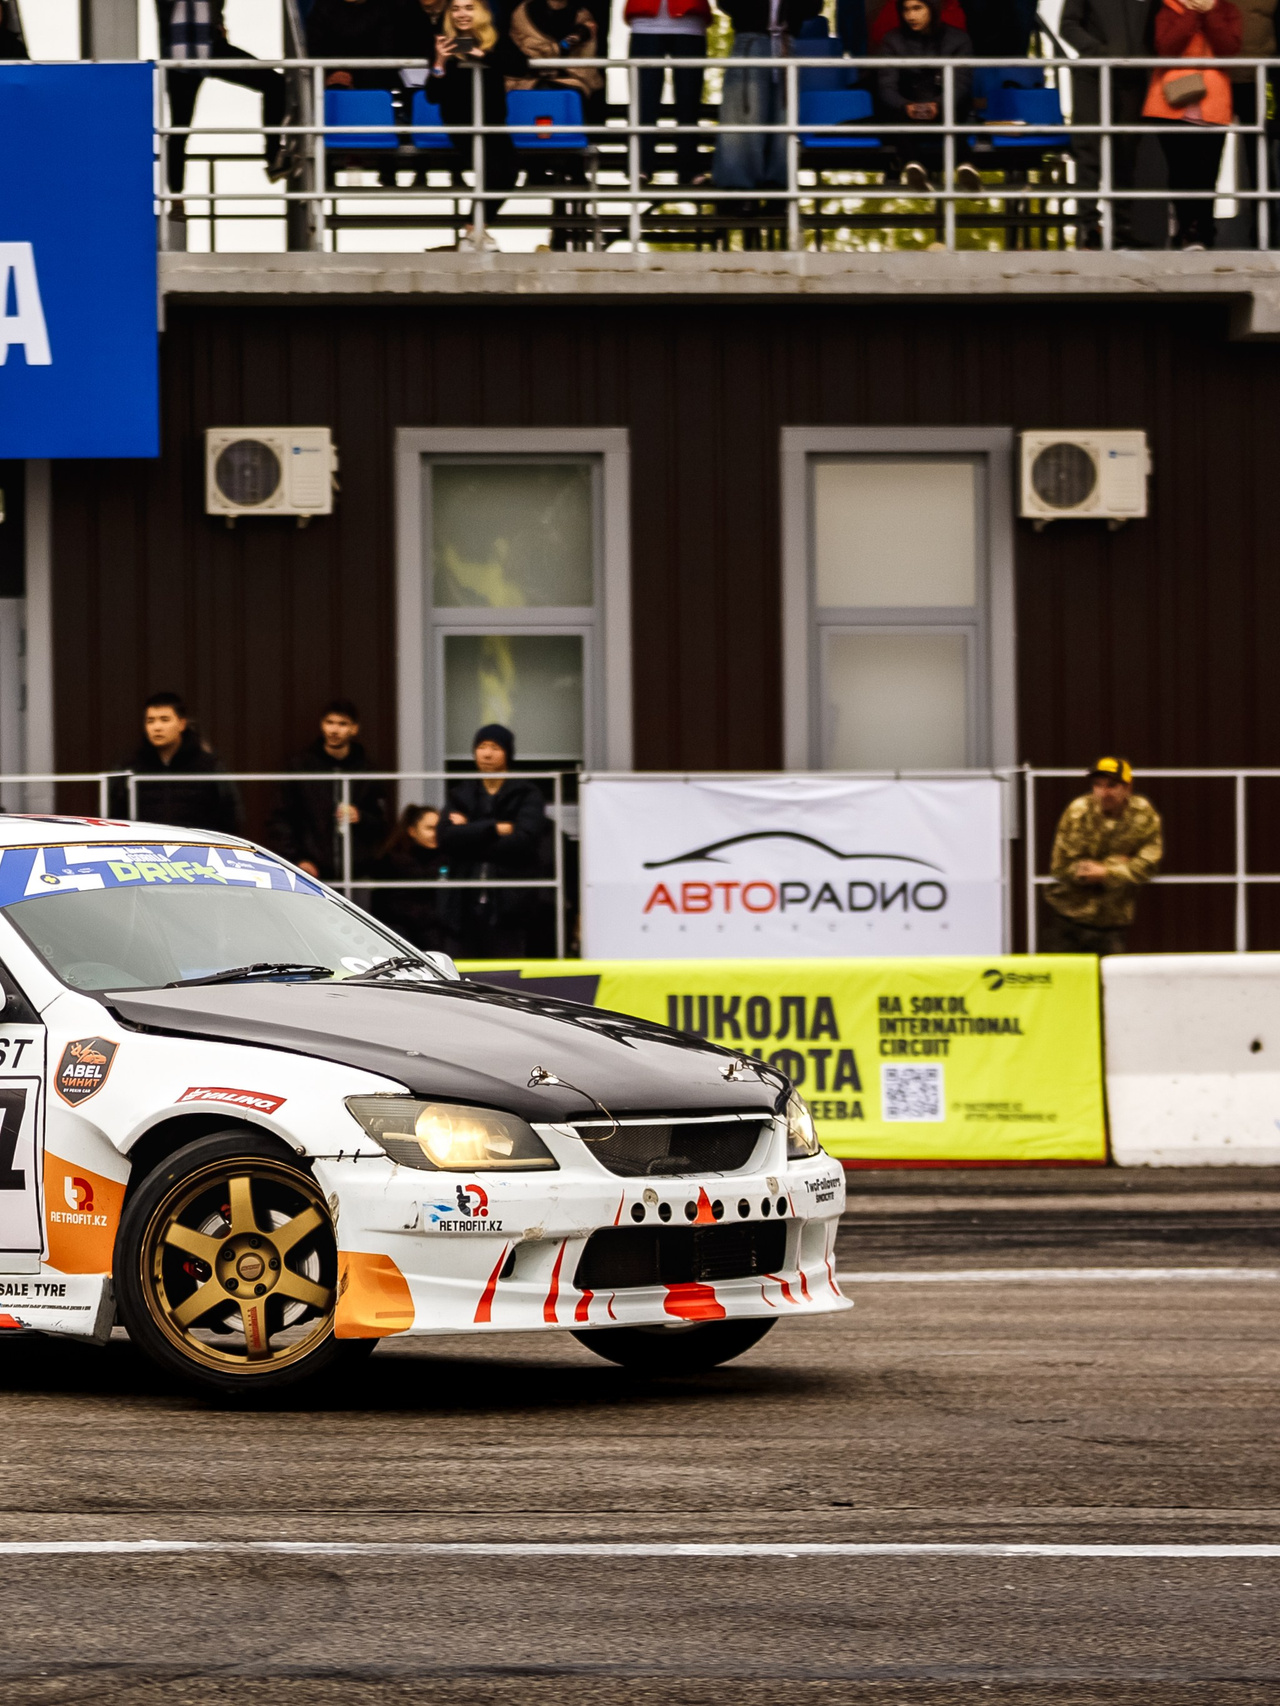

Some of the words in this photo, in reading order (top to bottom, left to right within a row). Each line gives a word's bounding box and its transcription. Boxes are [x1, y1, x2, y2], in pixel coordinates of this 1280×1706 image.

[107, 861, 228, 885] DRIFT
[910, 996, 969, 1015] SOKOL
[667, 994, 841, 1041] ШКОЛА
[878, 1017, 1024, 1036] INTERNATIONAL
[879, 1038, 951, 1057] CIRCUIT
[62, 1063, 103, 1078] ABEL
[61, 1077, 100, 1087] ЧИНИТ
[50, 1211, 108, 1227] RETROFIT.KZ
[439, 1220, 503, 1231] RETROFIT.KZ
